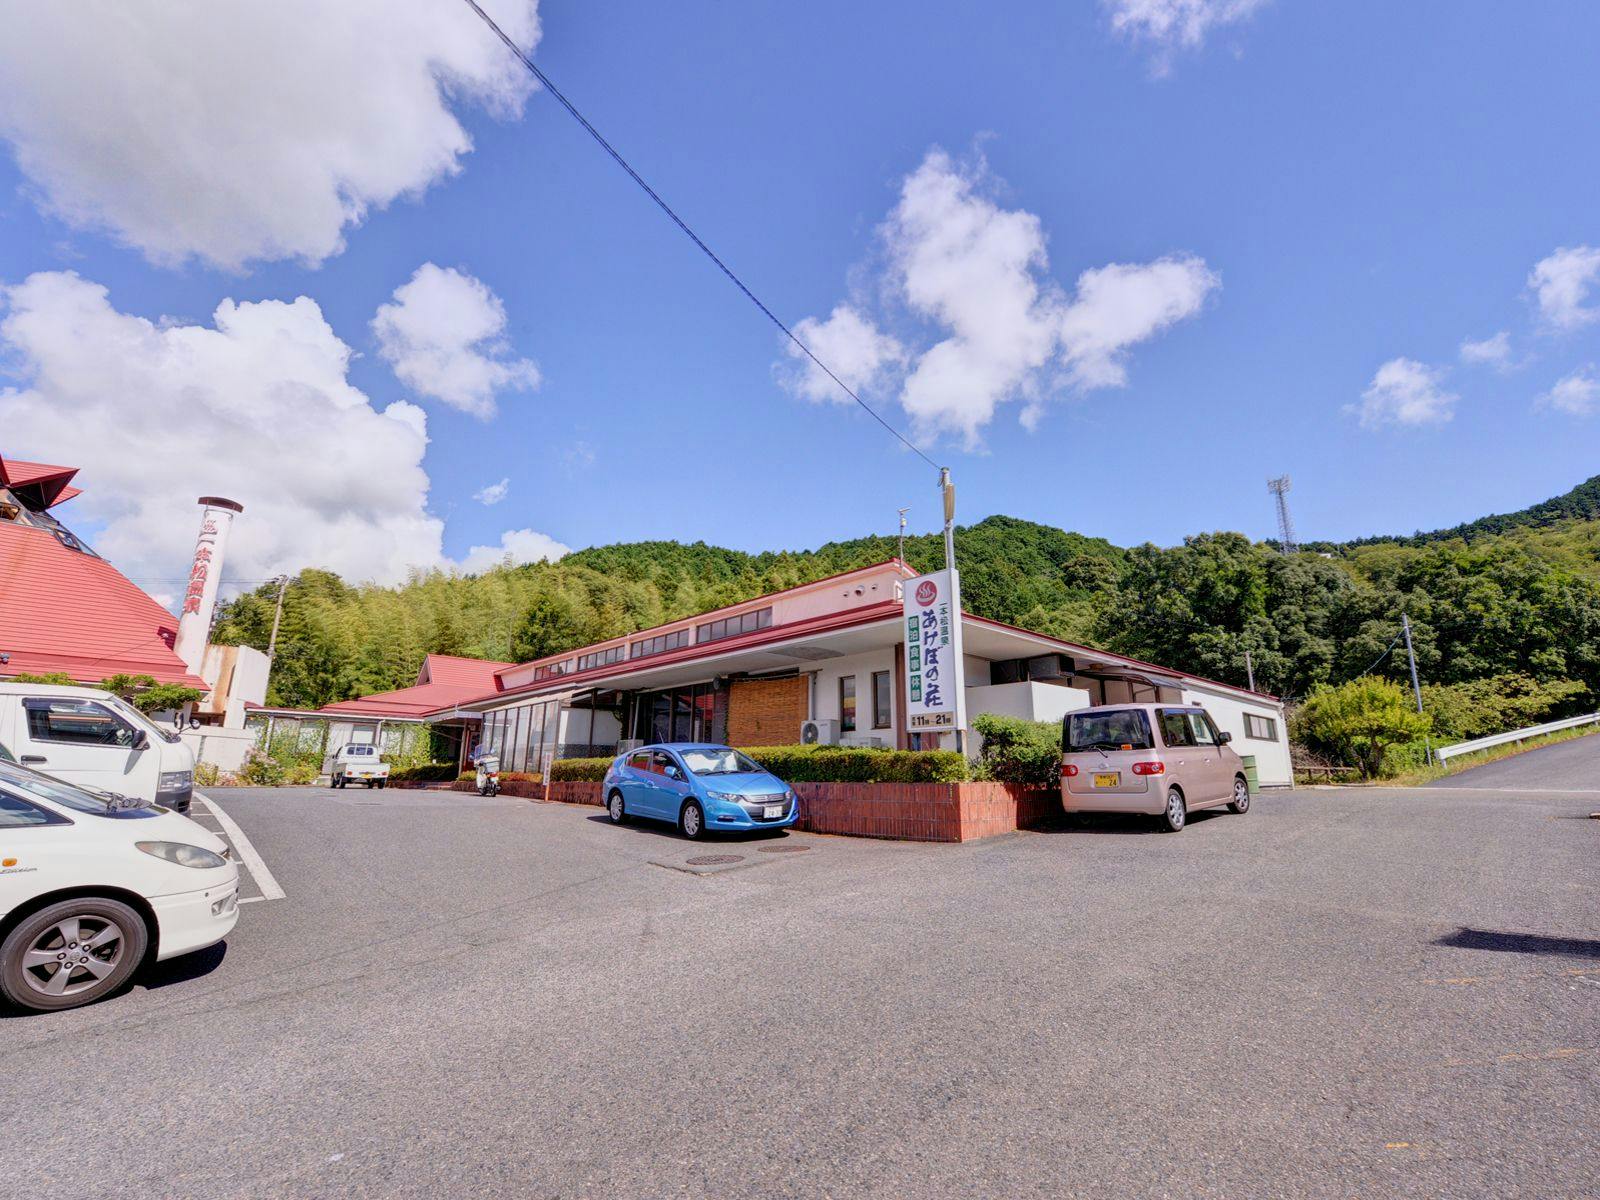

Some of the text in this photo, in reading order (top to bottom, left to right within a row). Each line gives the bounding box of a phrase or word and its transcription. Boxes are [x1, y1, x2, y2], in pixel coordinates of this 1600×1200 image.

[184, 539, 215, 616] 一本松温泉
[922, 608, 943, 708] あけぼの荘
[939, 602, 950, 646] 一本松温泉
